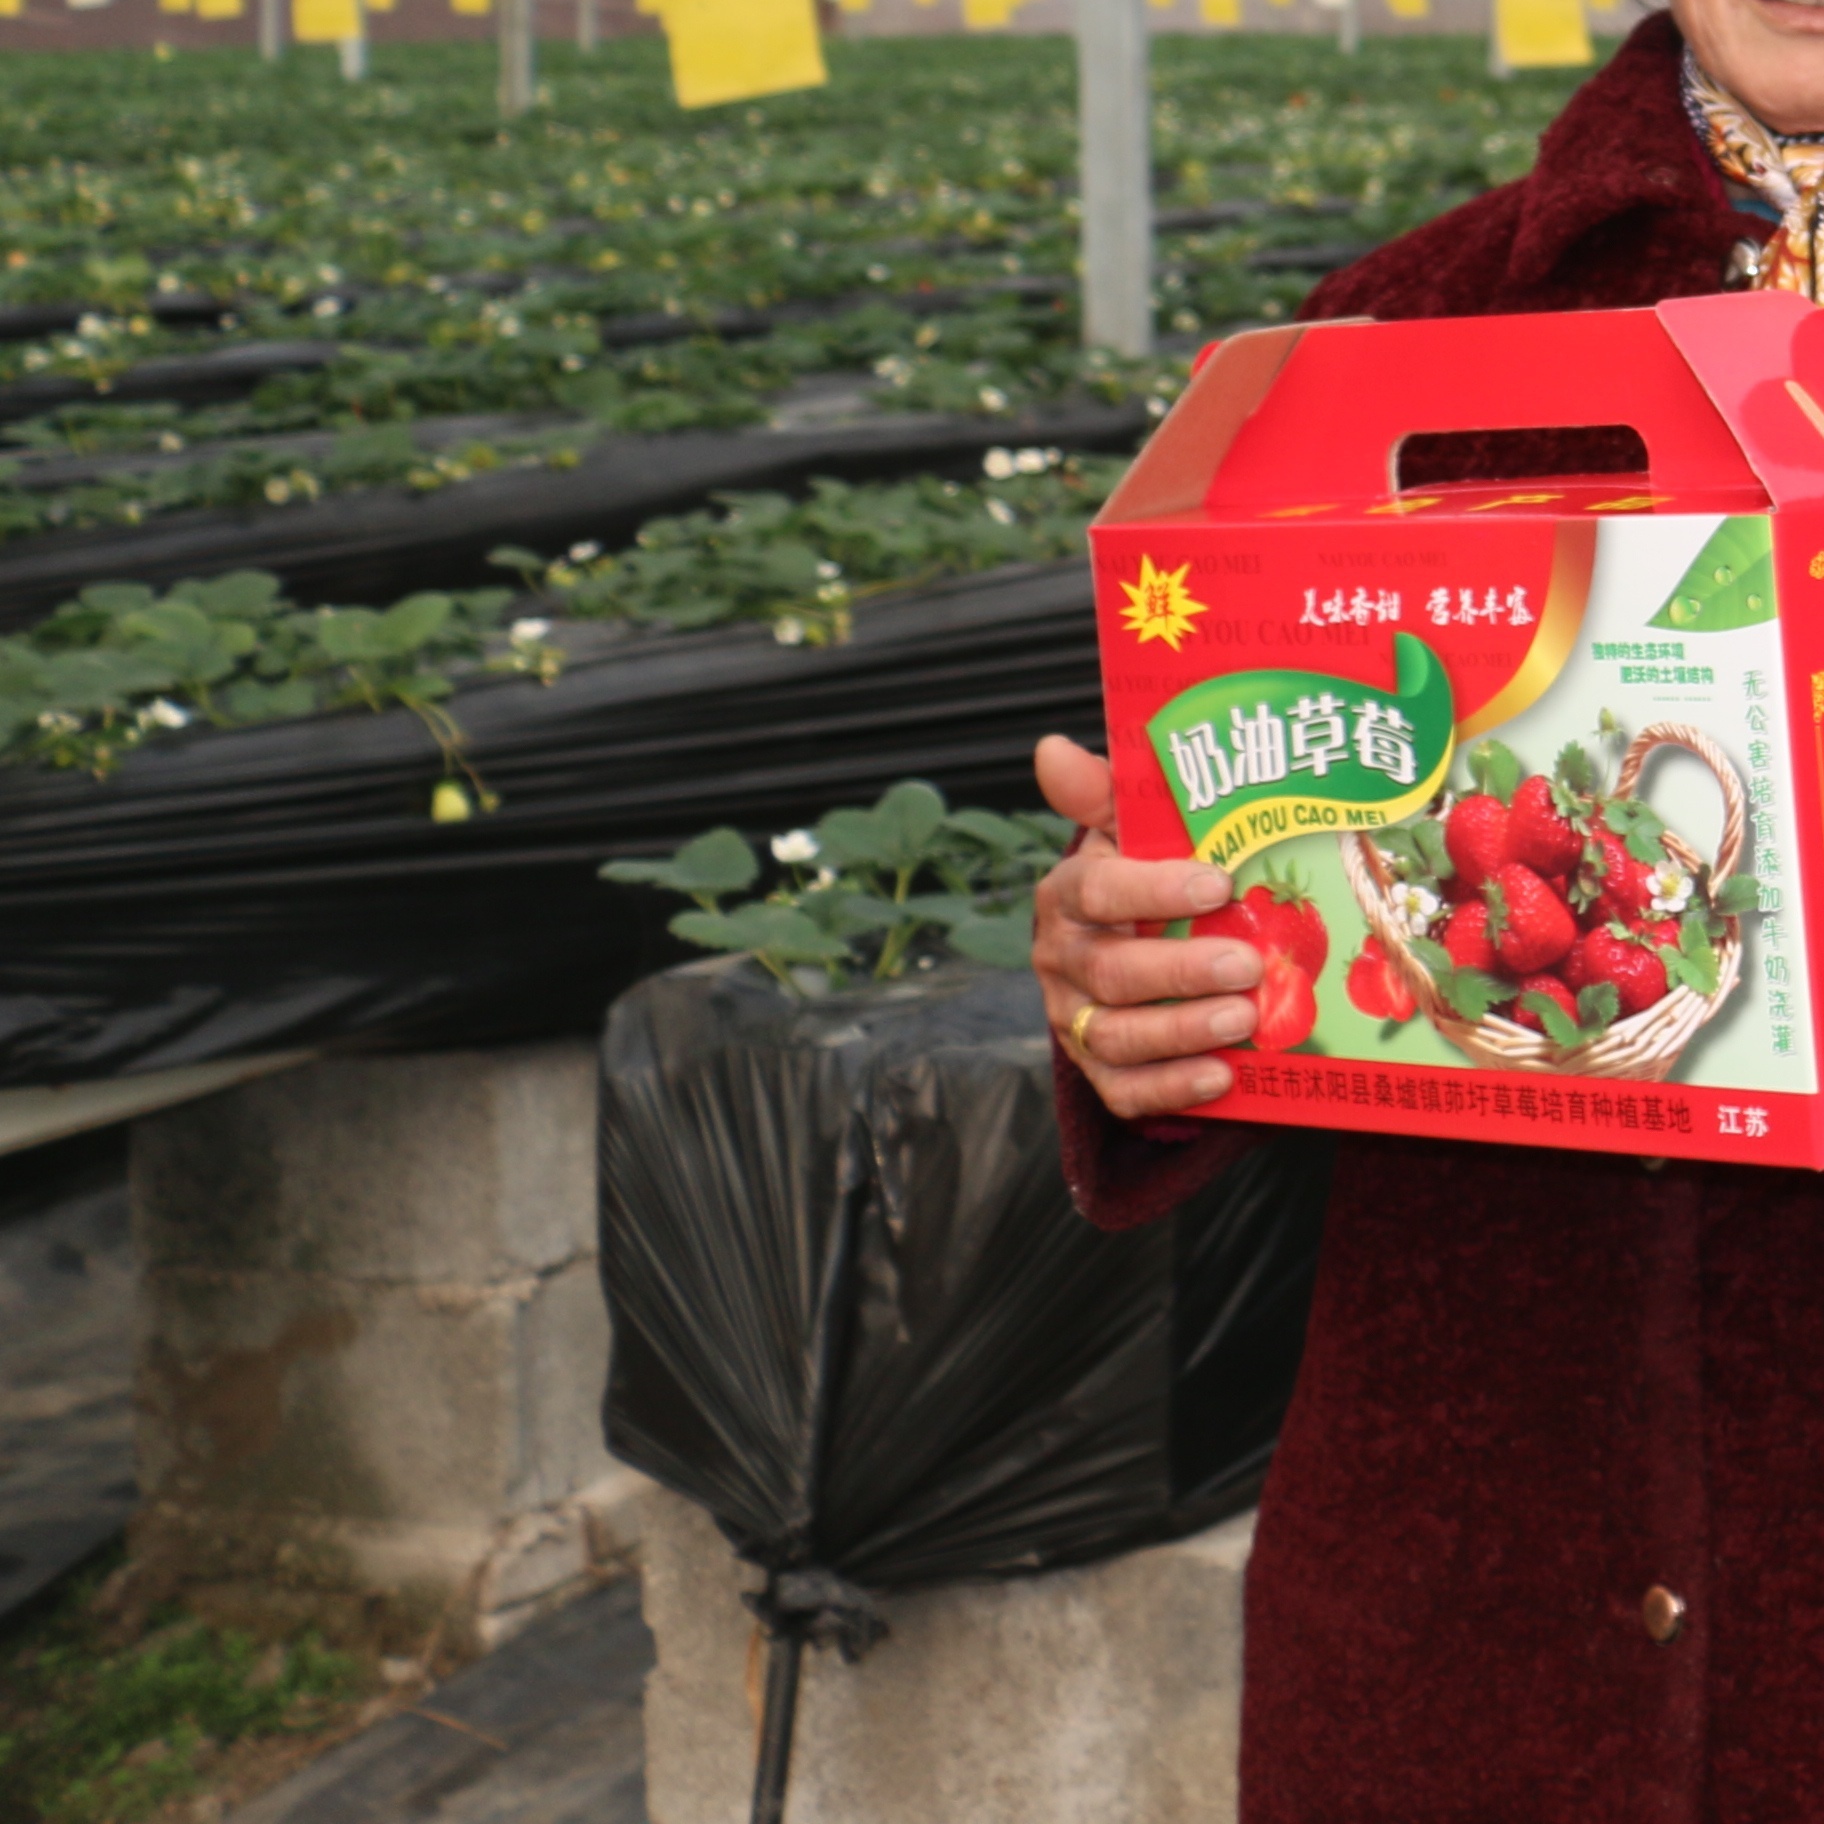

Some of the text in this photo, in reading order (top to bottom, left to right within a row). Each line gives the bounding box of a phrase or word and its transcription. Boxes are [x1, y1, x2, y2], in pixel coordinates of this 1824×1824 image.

[1299, 585, 1534, 626] 美味香甜 营养丰富
[1169, 691, 1418, 813] 奶油草莓
[1209, 803, 1388, 868] NAI YOU CAO MEI
[1743, 668, 1796, 1056] 无公害培育添加牛奶浇灌
[1717, 1104, 1770, 1138] 江苏
